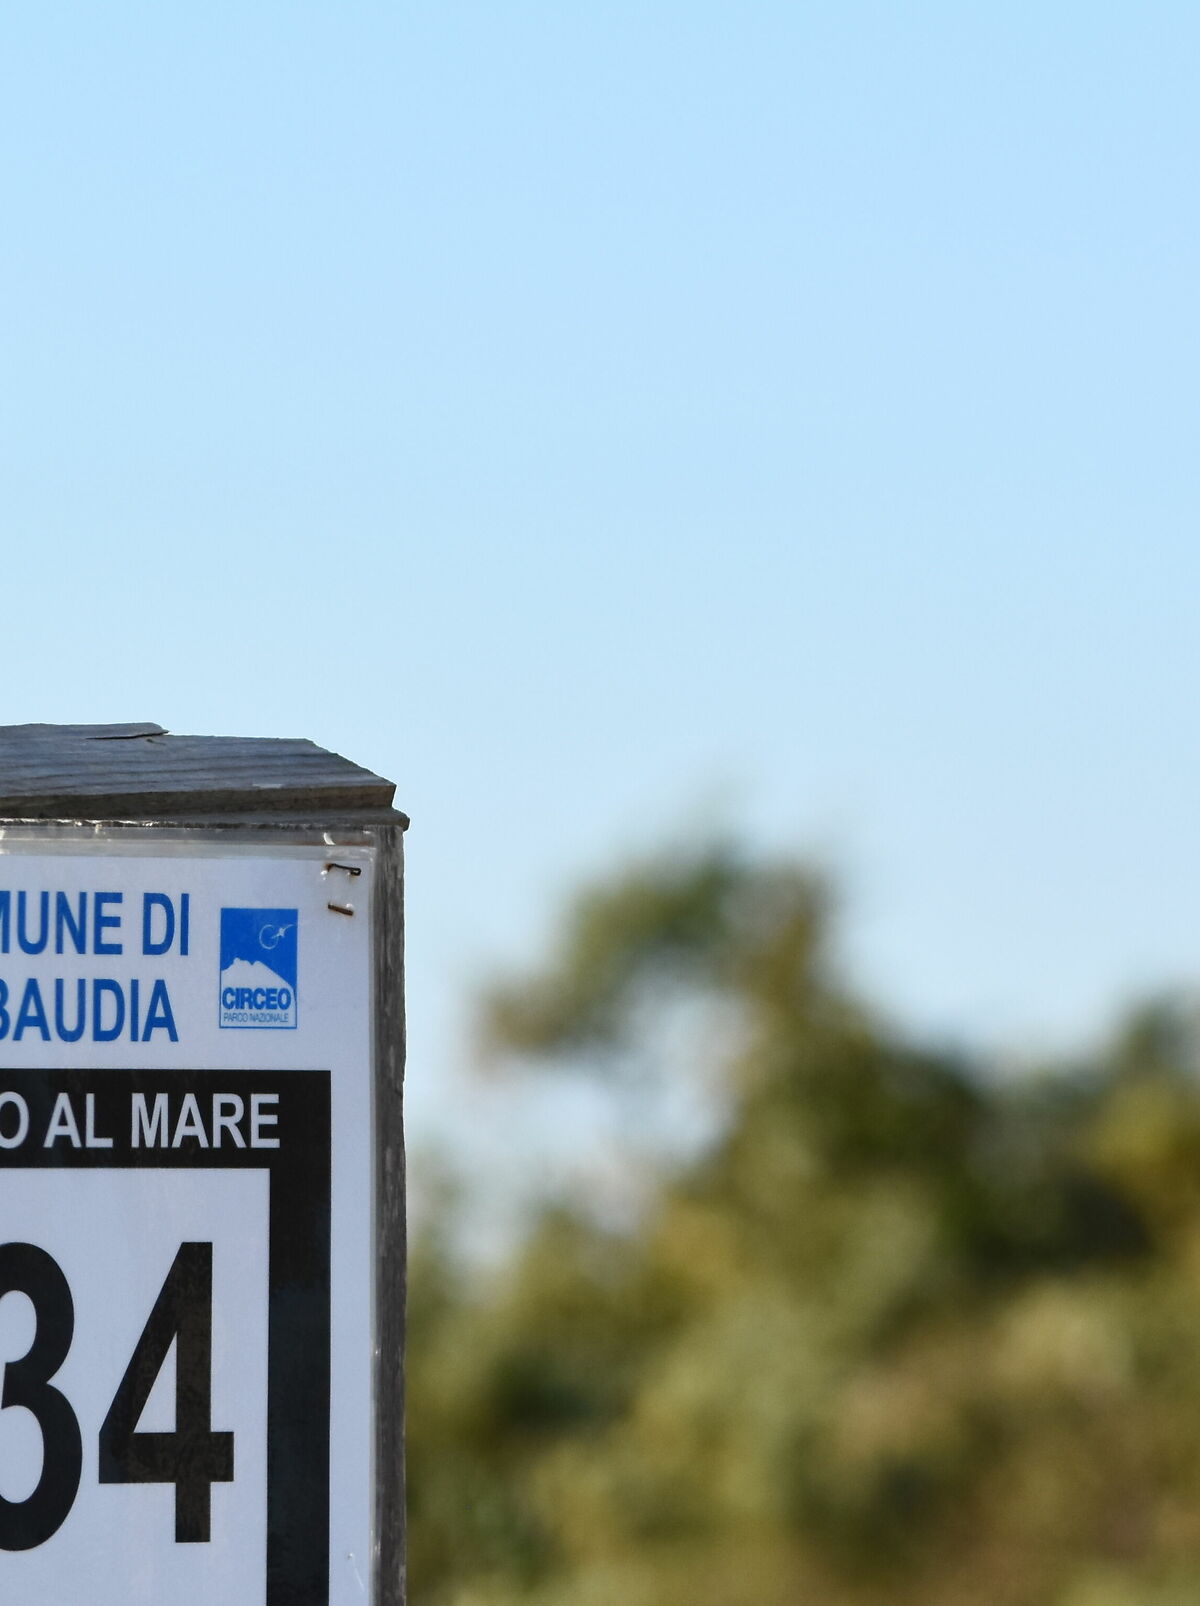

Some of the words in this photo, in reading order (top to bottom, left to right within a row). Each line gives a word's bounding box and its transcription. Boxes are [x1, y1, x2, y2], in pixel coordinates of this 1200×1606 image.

[142, 892, 190, 956] DI
[222, 987, 291, 1010] CIRCEO
[223, 1012, 248, 1022] PARCO
[249, 1012, 289, 1022] NAZIONALE
[44, 1092, 113, 1149] AL
[131, 1093, 281, 1150] MARE
